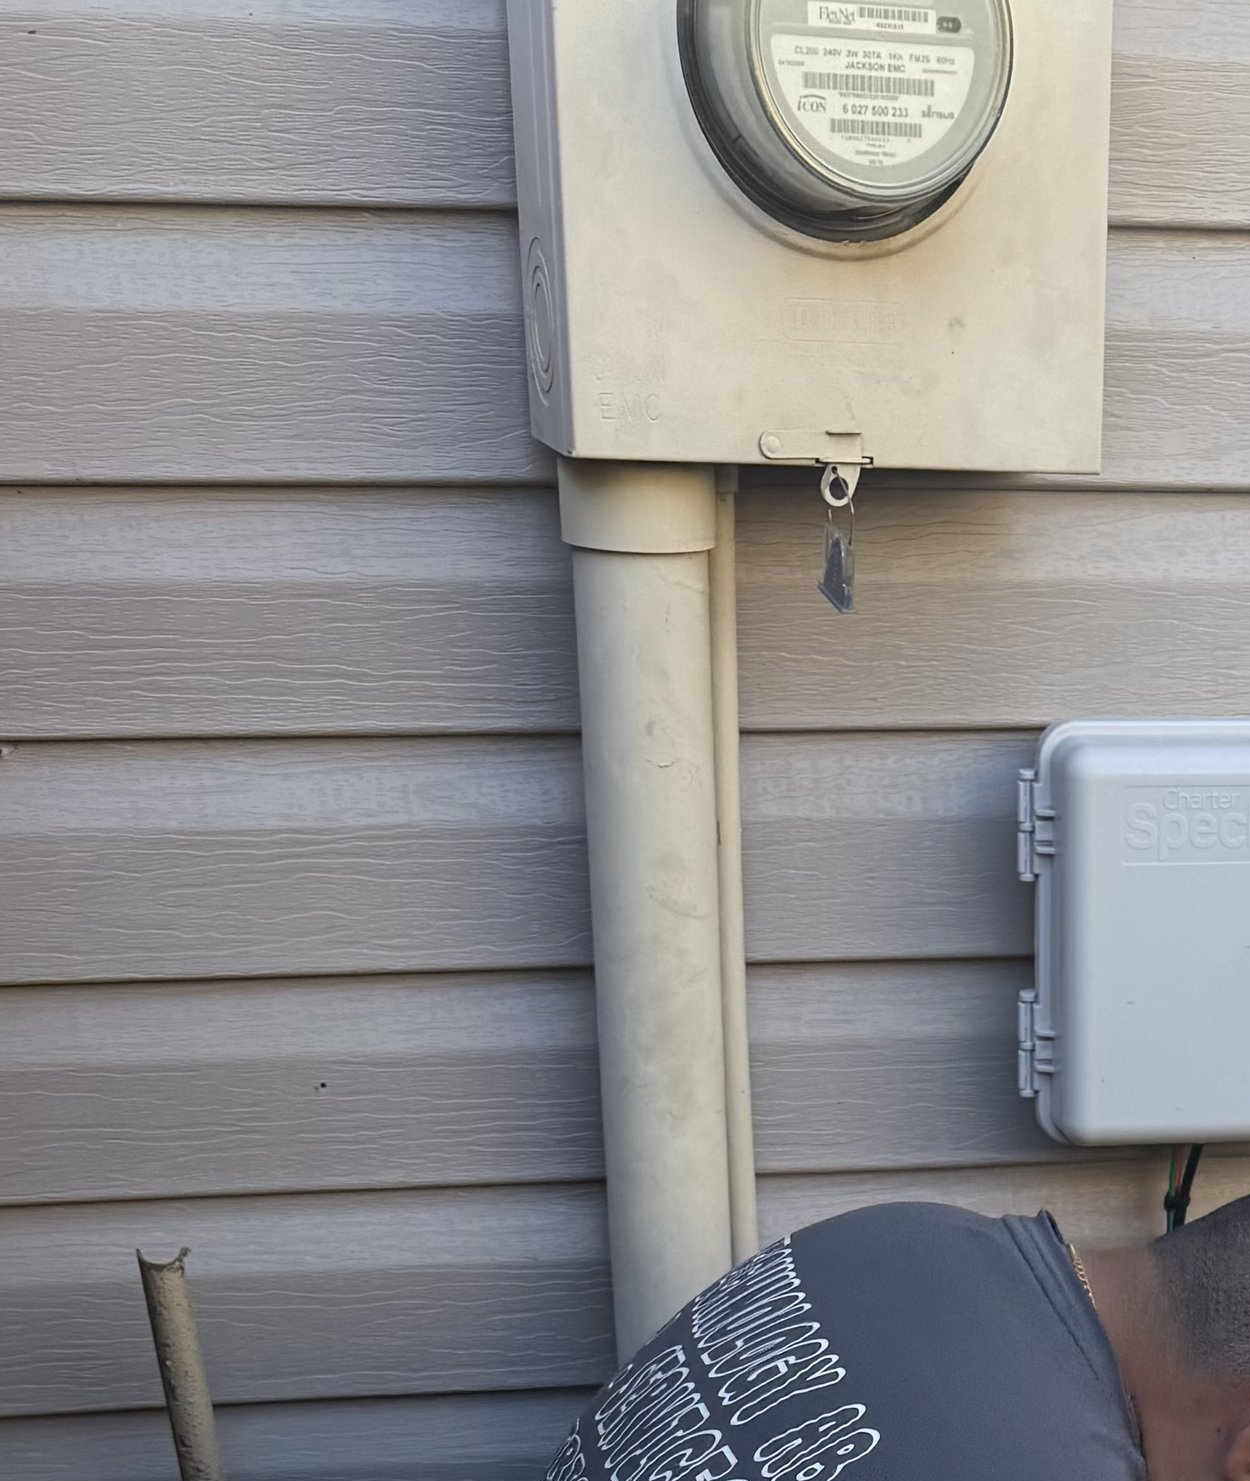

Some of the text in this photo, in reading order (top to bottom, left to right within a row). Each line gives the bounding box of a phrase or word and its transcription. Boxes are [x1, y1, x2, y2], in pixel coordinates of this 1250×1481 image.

[845, 60, 906, 73] JACKSON EMC
[842, 102, 849, 115] 6
[851, 103, 869, 116] 027
[871, 104, 889, 117] 500
[891, 105, 909, 118] 233
[1163, 788, 1240, 810] Charter
[692, 1235, 847, 1426] CHNOLOGY
